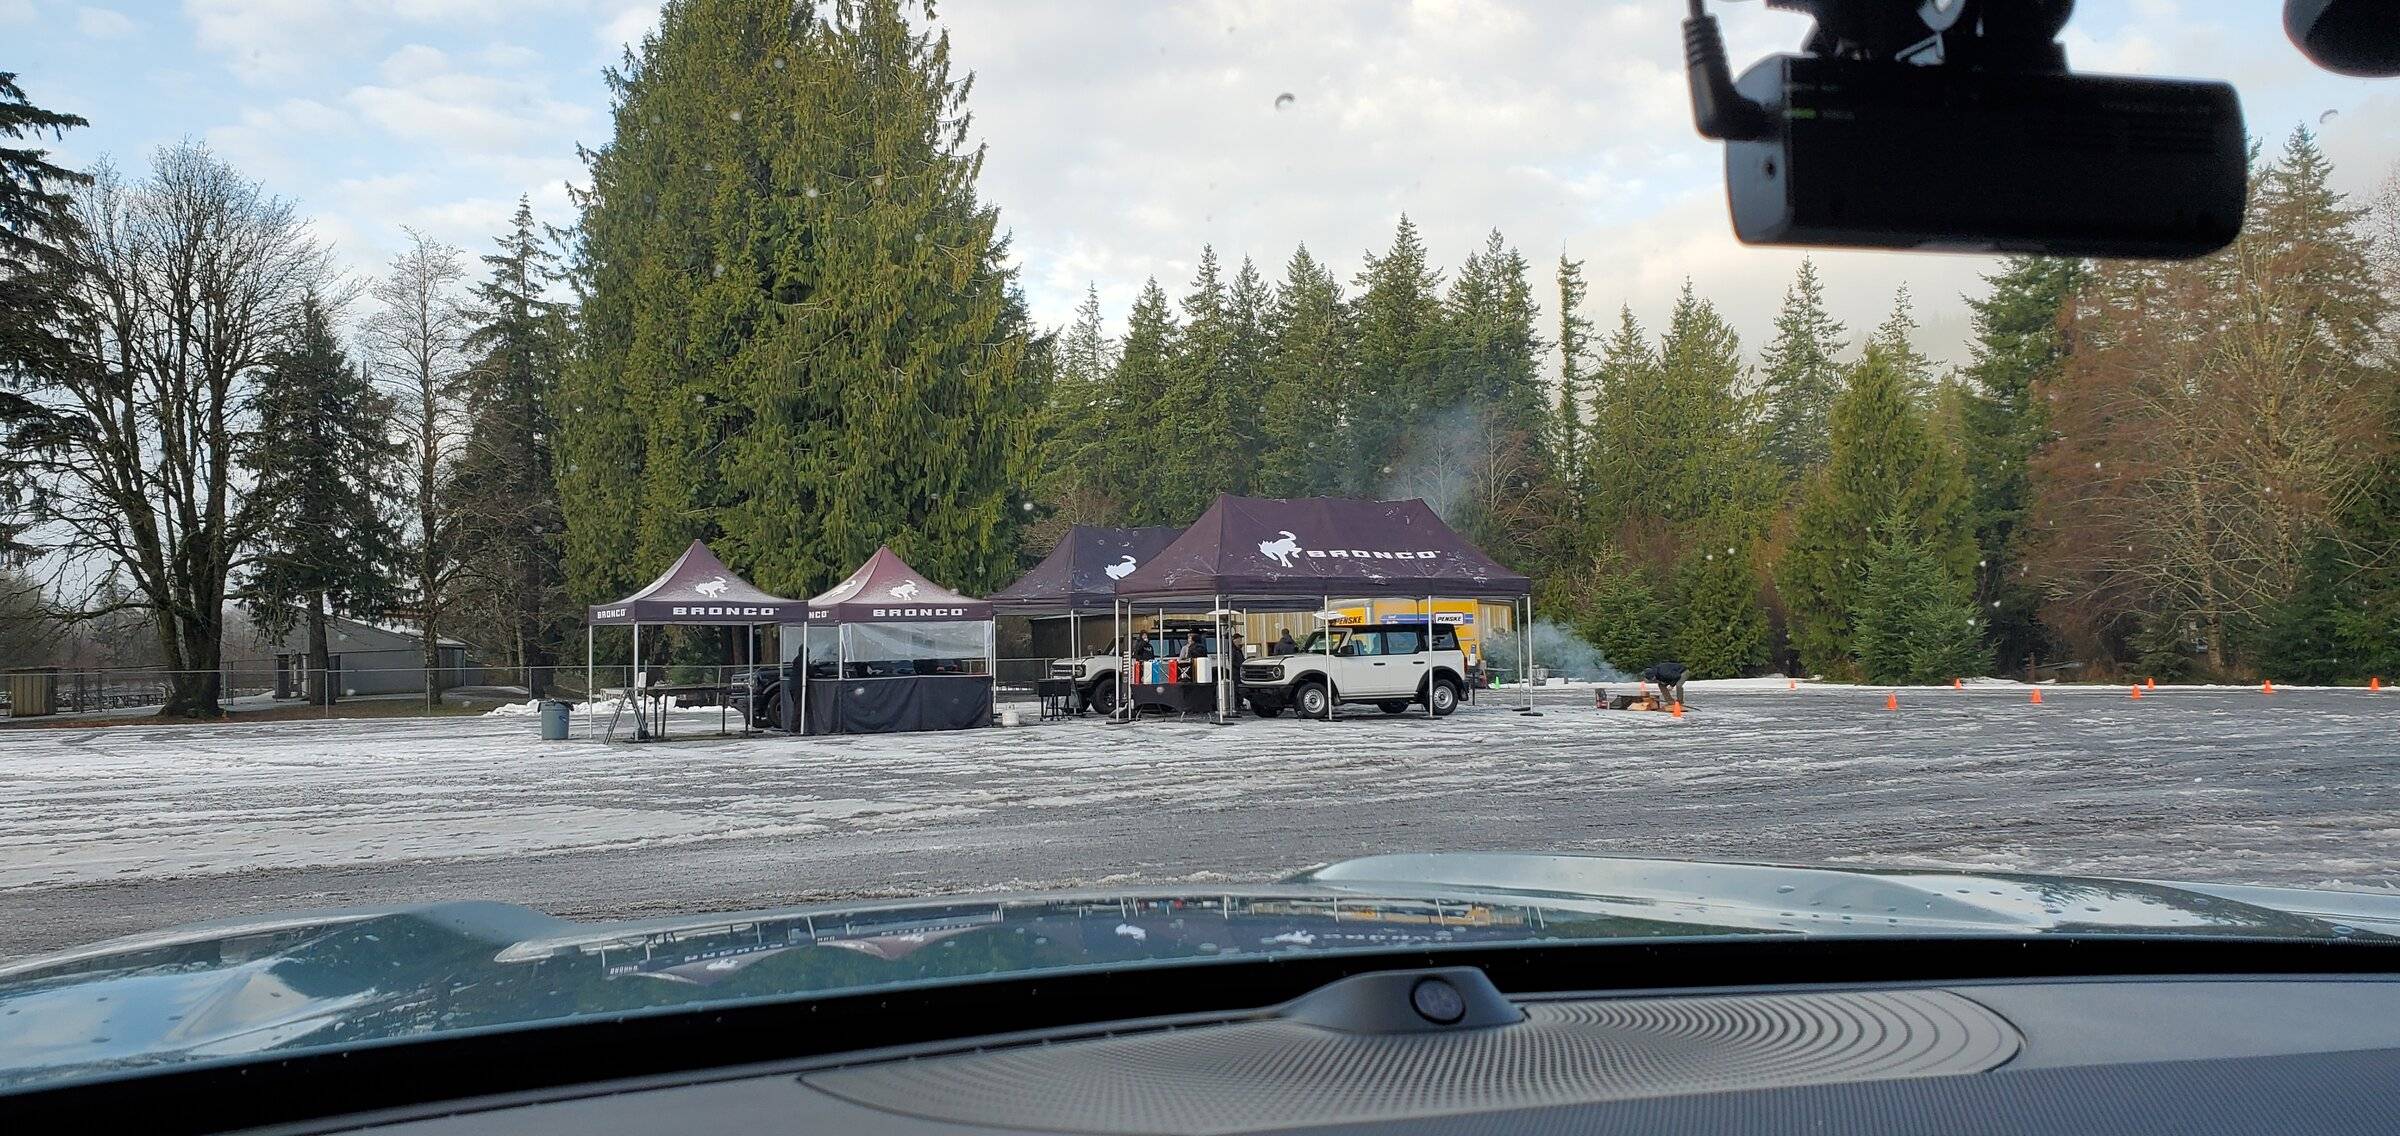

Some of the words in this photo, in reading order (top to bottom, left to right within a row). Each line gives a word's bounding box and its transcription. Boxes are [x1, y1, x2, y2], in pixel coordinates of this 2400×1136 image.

[1306, 550, 1436, 559] BRONCO
[597, 608, 626, 619] BRONCO
[673, 607, 774, 616] BRONCO
[873, 609, 963, 617] BRONCO
